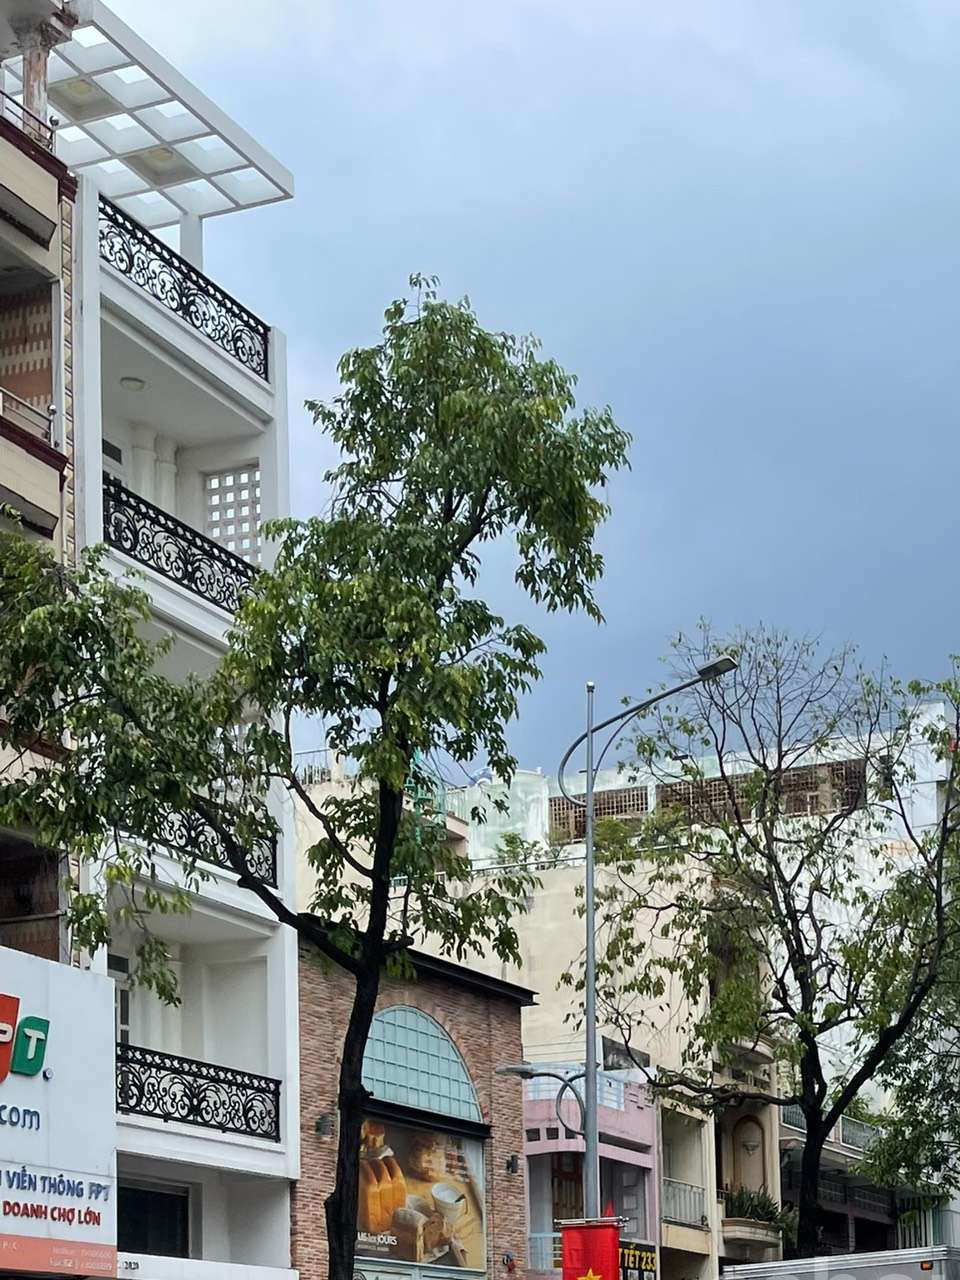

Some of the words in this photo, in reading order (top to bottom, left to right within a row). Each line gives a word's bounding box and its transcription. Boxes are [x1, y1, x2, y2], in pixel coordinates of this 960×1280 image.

[40, 1173, 84, 1198] THÔNG
[88, 1182, 111, 1202] FPT
[3, 1200, 48, 1220] DOANH
[50, 1206, 76, 1226] CHỢ
[78, 1206, 101, 1226] LỚN
[641, 1251, 657, 1271] 233
